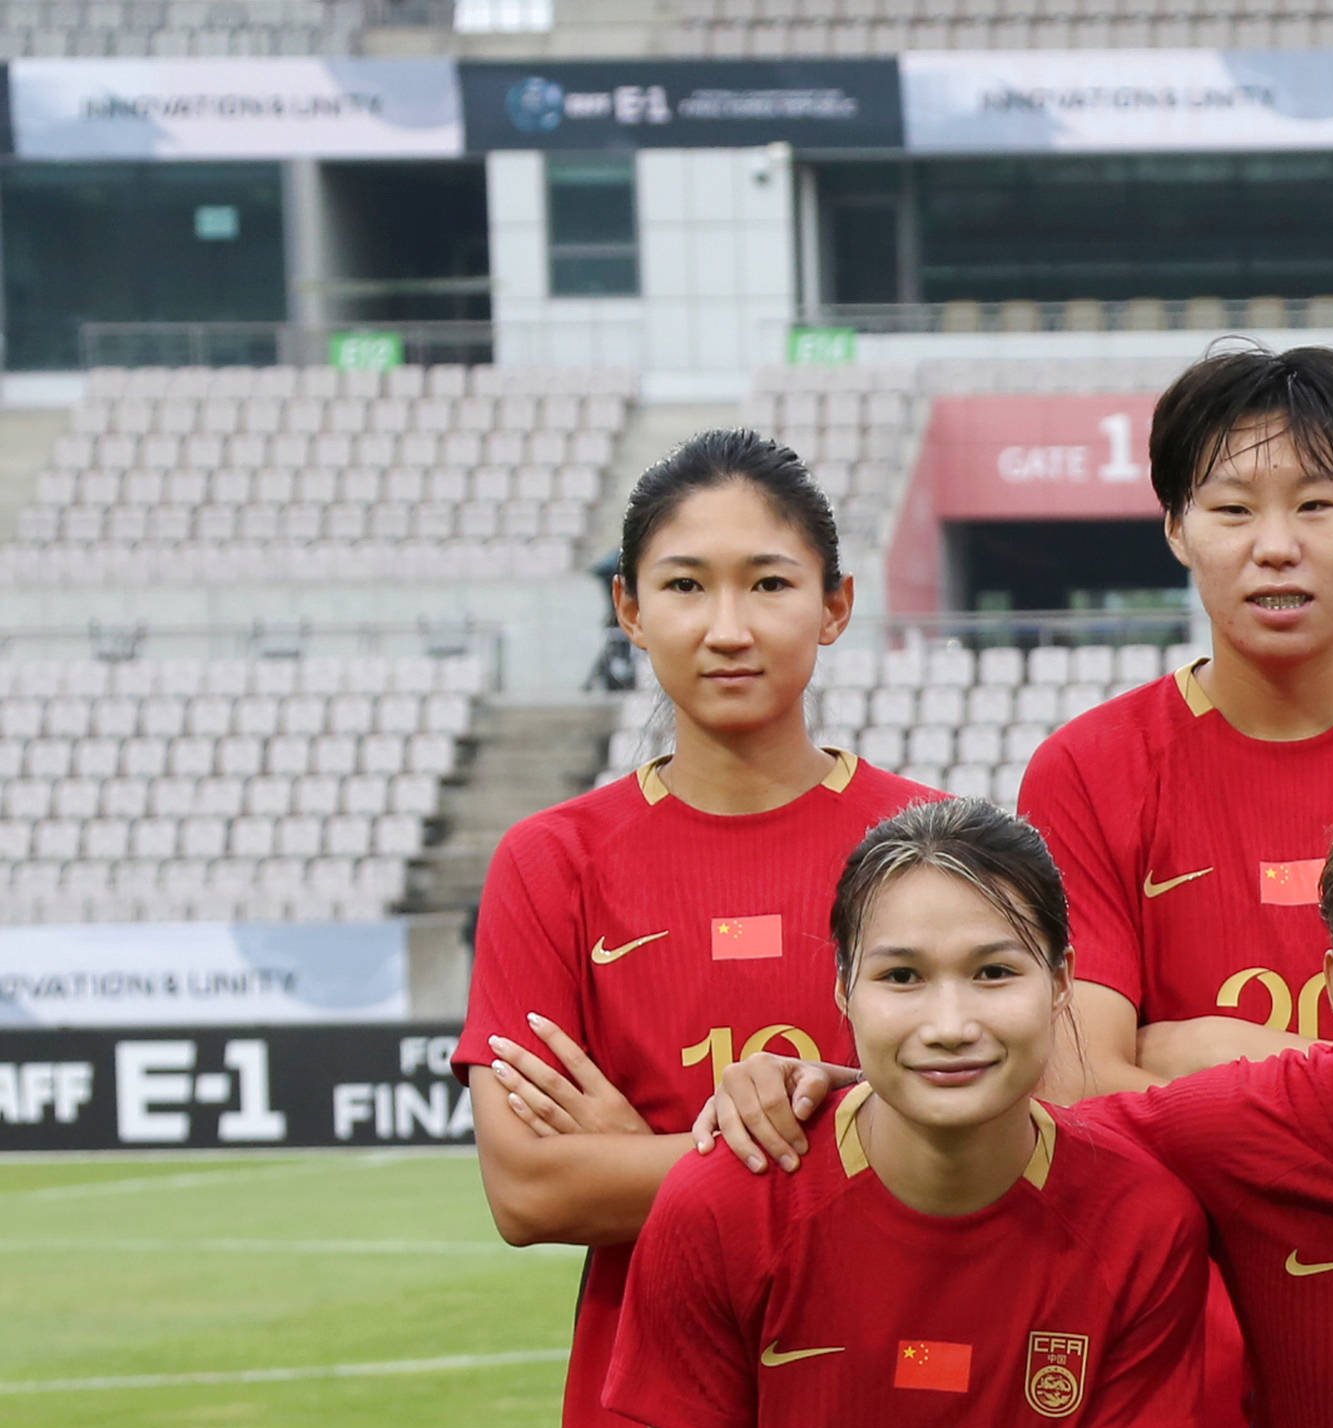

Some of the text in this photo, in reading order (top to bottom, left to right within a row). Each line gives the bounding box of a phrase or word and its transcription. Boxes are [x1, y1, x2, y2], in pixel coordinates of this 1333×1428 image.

[998, 412, 1151, 484] GATE 1
[115, 1038, 287, 1143] E-1
[1034, 1337, 1083, 1356] CFA
